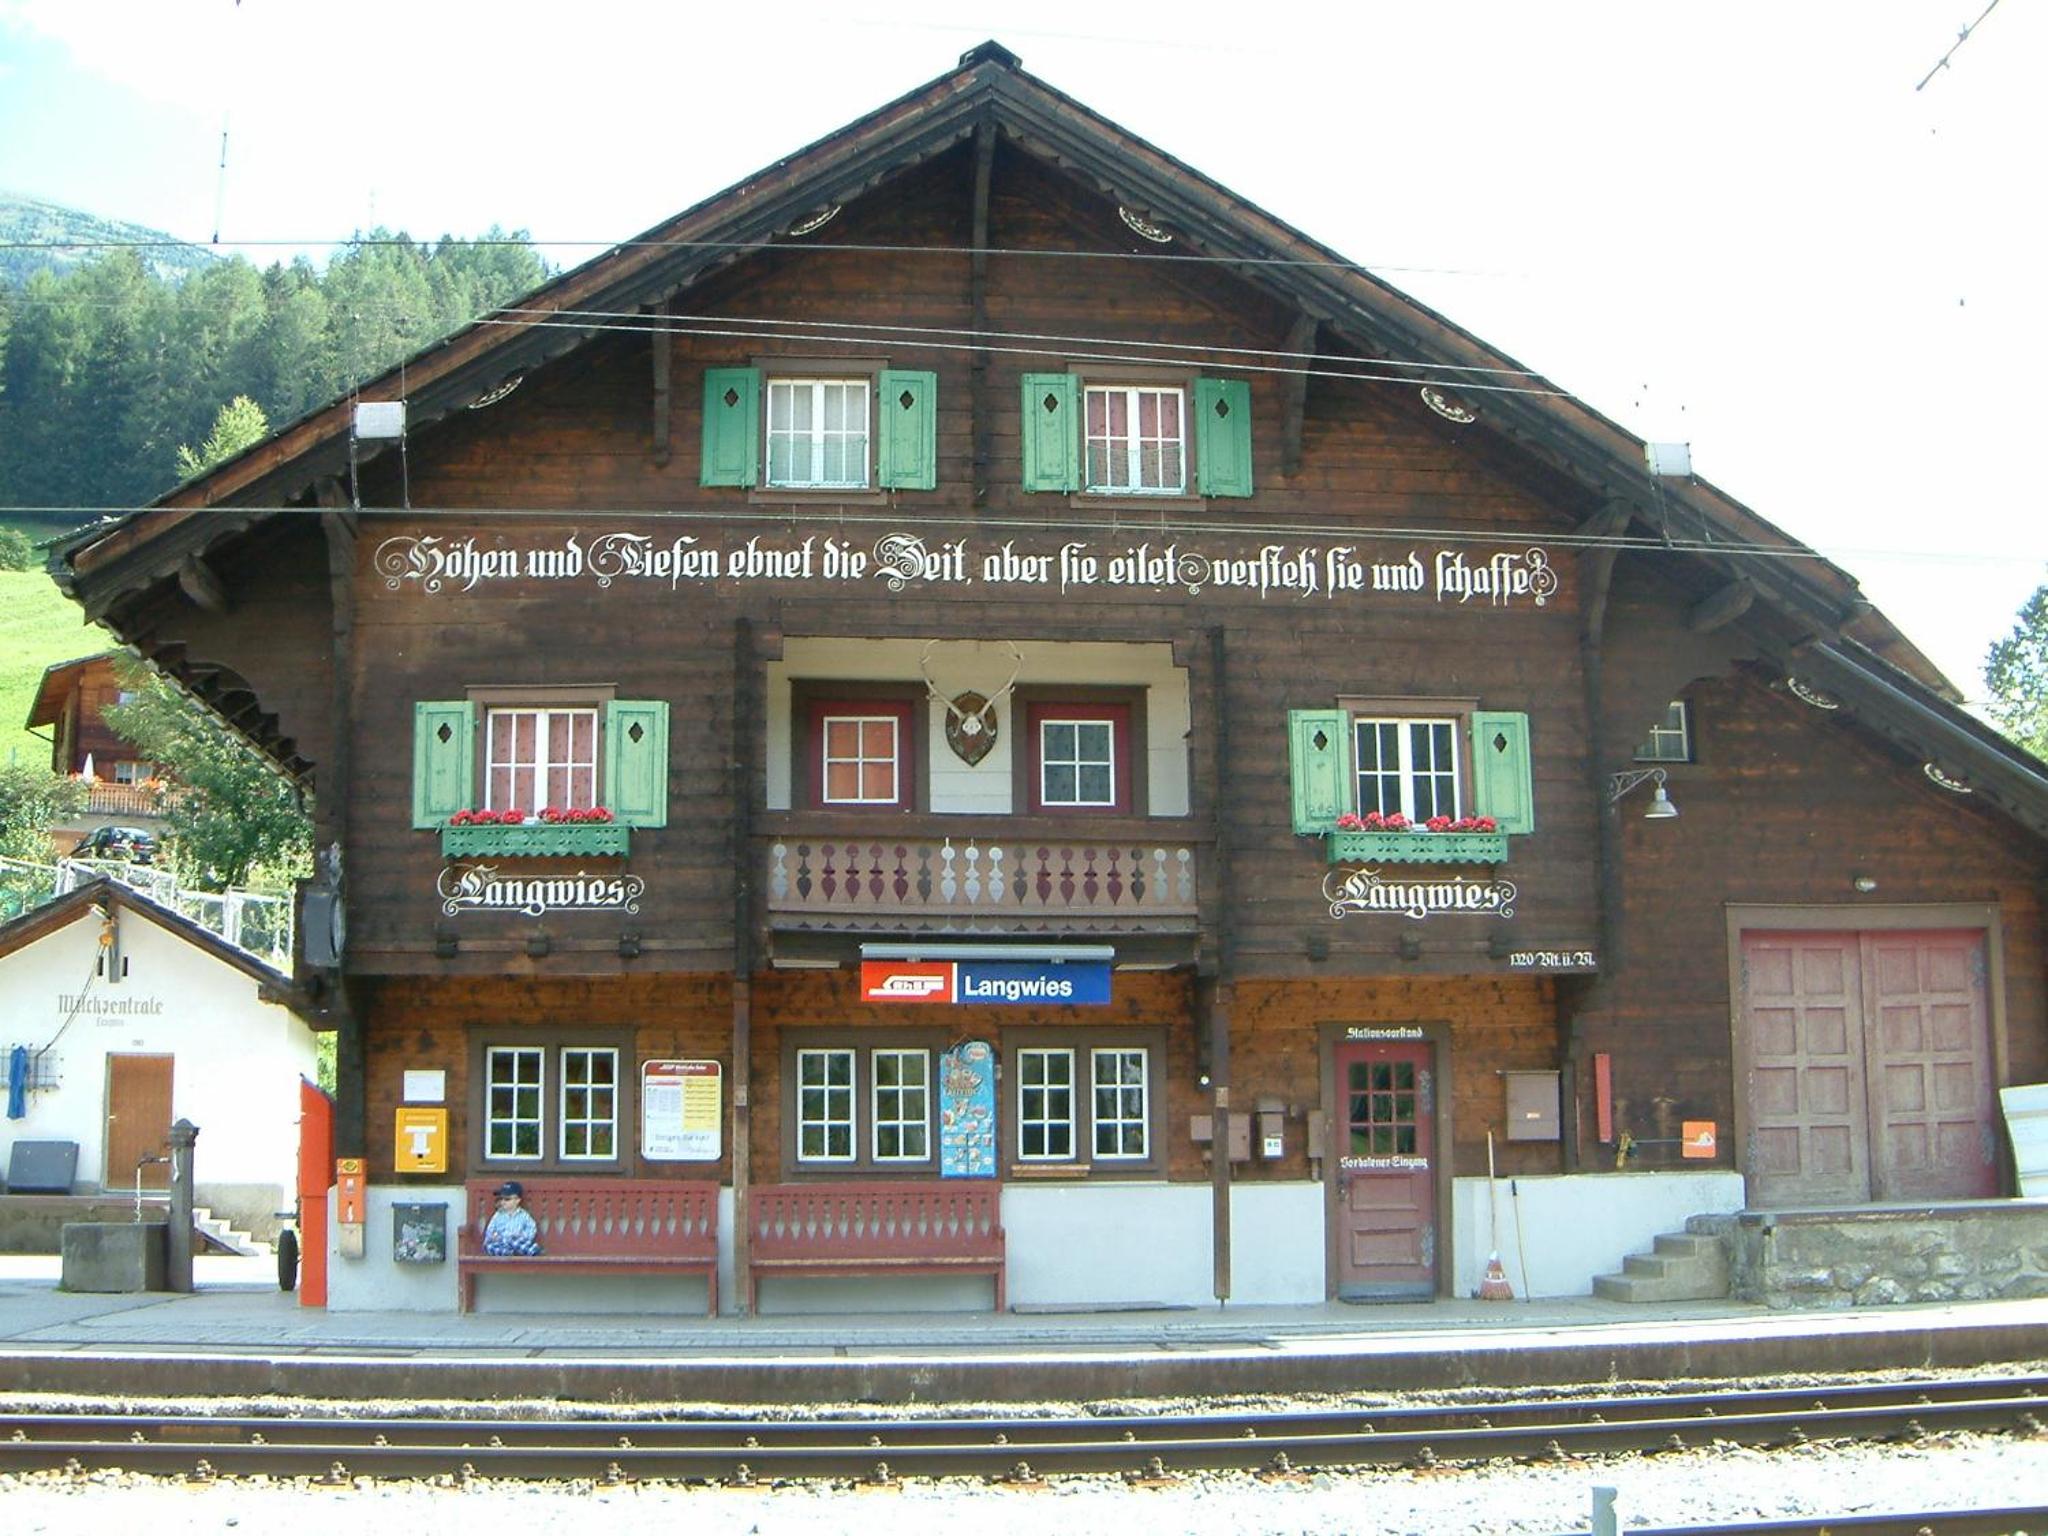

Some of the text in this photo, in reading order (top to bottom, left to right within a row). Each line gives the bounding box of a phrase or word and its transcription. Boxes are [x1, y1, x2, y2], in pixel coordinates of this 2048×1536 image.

[375, 535, 520, 594] Höhen
[524, 529, 583, 580] und
[588, 533, 720, 590] Tiefen
[726, 535, 815, 580] ebnet
[822, 535, 867, 579] die
[872, 532, 973, 592] Zeit,
[982, 539, 1054, 584] aber
[1060, 542, 1098, 595] sie
[1108, 543, 1180, 586] eilet
[1371, 549, 1424, 593] und
[438, 864, 626, 916] Langwies
[1322, 868, 1501, 919] Langwies
[965, 976, 1073, 1000] Langwies
